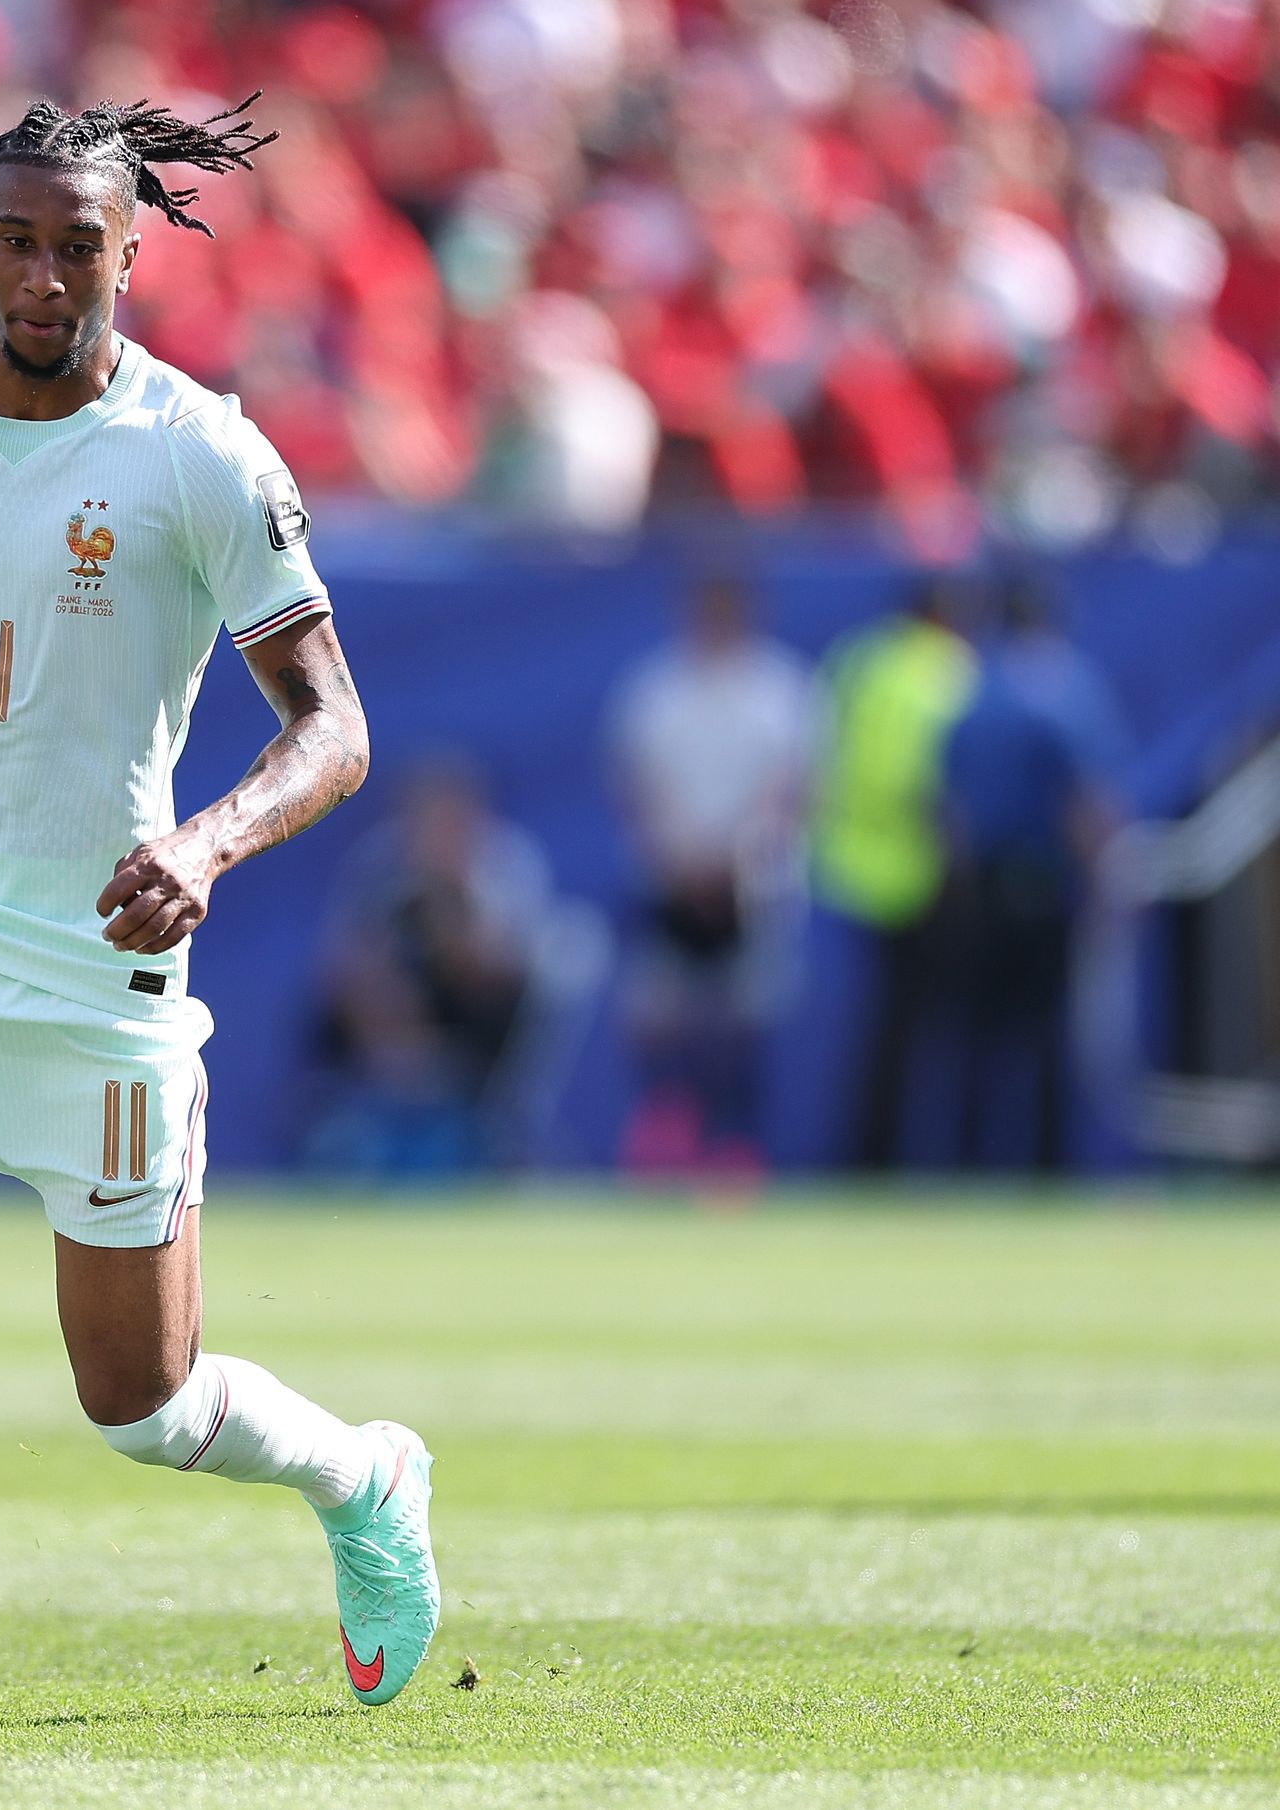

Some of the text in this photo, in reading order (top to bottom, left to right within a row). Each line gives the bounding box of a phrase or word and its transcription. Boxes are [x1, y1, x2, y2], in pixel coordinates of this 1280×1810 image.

[75, 582, 101, 591] FFF
[57, 595, 81, 605] FRANCE
[88, 598, 114, 608] MAROC
[55, 605, 114, 617] 09 JUILLET 2026
[102, 1080, 148, 1181] 11
